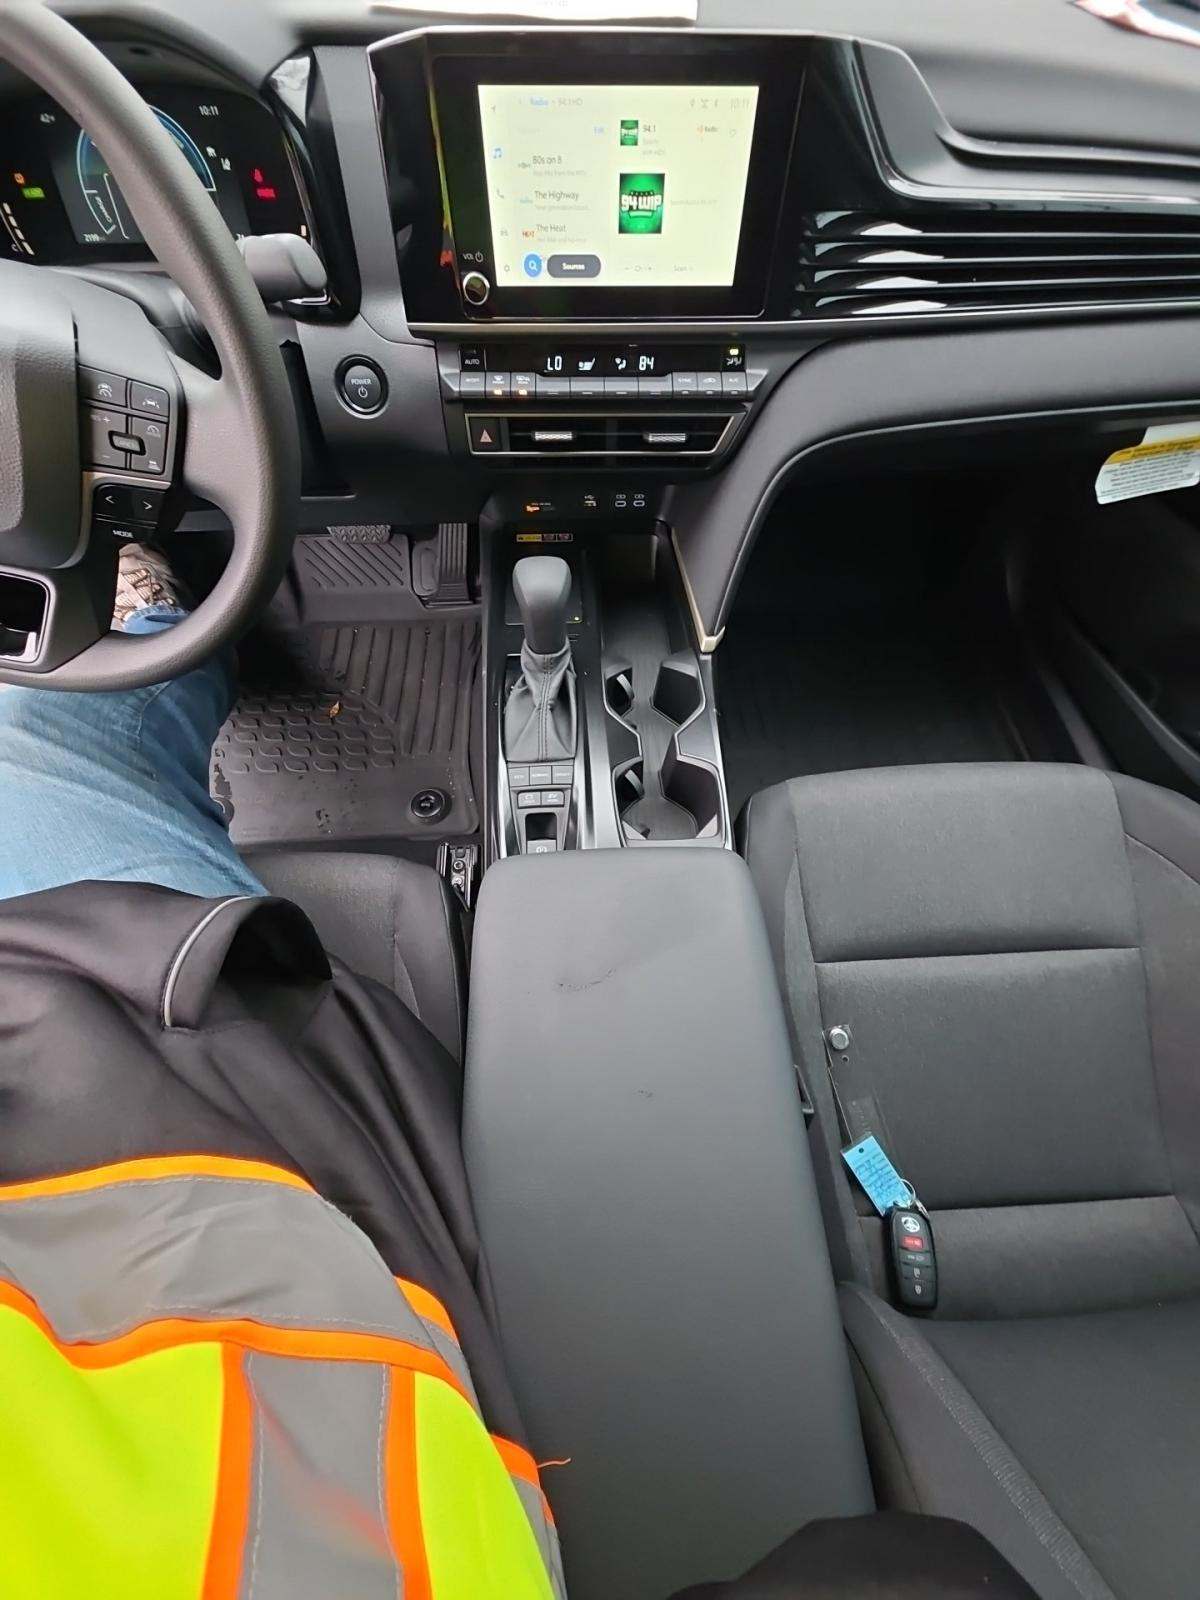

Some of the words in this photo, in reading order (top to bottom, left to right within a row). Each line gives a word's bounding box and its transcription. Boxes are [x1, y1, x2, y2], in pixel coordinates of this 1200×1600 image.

[199, 105, 219, 115] 10:11
[546, 157, 557, 165] on
[534, 190, 547, 199] The
[548, 190, 580, 201] Highway
[536, 224, 549, 232] The
[550, 224, 567, 232] Heat
[547, 356, 562, 370] LO
[639, 356, 654, 370] 84
[112, 530, 134, 538] MODE
